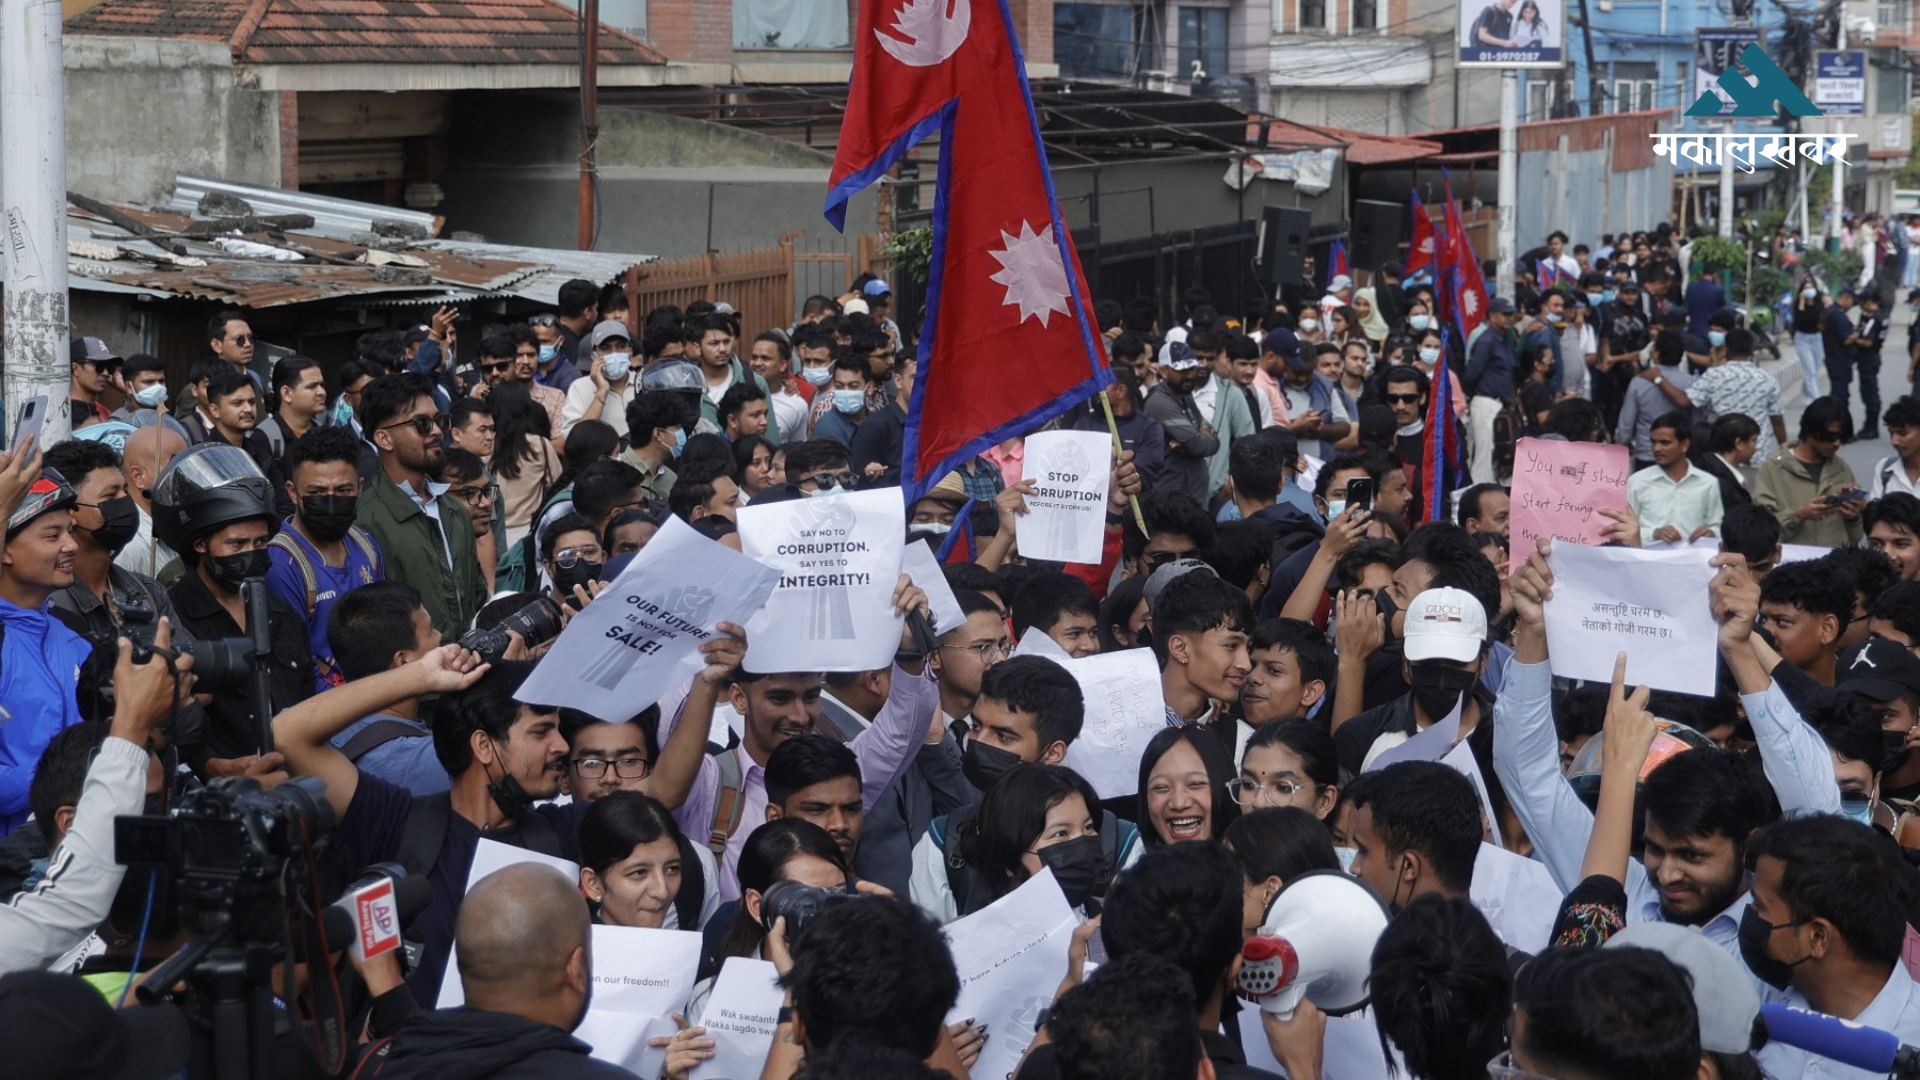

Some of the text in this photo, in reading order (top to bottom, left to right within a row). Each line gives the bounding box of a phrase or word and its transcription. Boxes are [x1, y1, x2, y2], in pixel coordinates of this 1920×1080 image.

[1525, 450, 1552, 475] You
[1048, 471, 1079, 483] STOP
[1023, 487, 1102, 502] ORRUPTION
[1060, 503, 1080, 511] STOPS
[800, 528, 846, 538] SAY NO TO
[1521, 527, 1539, 540] the
[800, 560, 817, 568] SAY
[819, 559, 834, 567] YES
[779, 573, 870, 588] INTEGRITY!
[1425, 604, 1462, 615] GUCCI
[1630, 605, 1650, 617] चरम
[626, 595, 711, 639] OUR FUTURE
[625, 613, 678, 640] IS NOT FOR
[1582, 616, 1612, 632] नेताको
[1614, 619, 1635, 634] गोजी
[1637, 625, 1657, 637] गरम
[605, 625, 663, 656] SALE!
[604, 976, 620, 984] our
[623, 976, 670, 988] freedom!!
[720, 1008, 737, 1020] Wak
[704, 1018, 730, 1032] Wakka
[732, 1023, 756, 1035] lagdo
